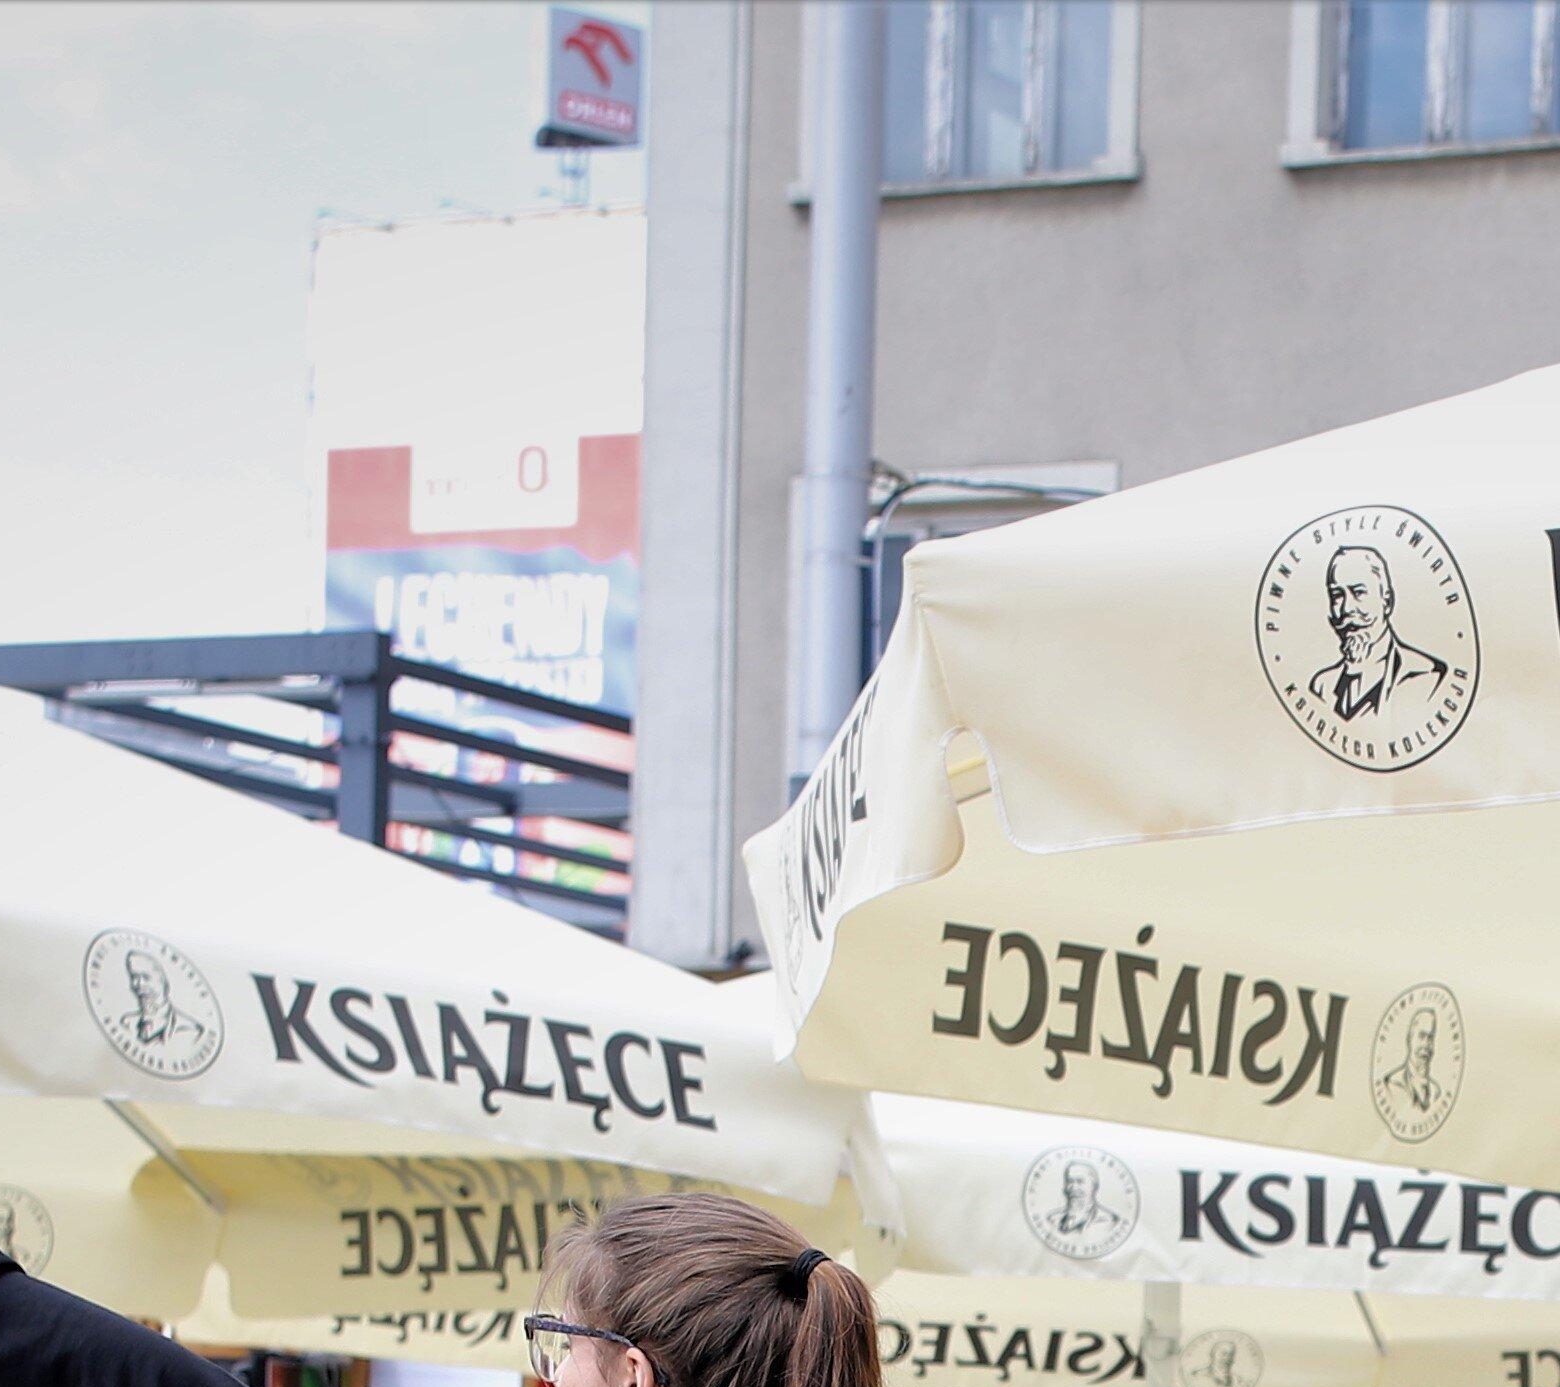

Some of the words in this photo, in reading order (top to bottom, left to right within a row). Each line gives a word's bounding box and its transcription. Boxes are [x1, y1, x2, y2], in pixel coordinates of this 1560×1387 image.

[1266, 550, 1302, 632] PIWNE
[1313, 515, 1380, 544] STYLE
[251, 989, 717, 1135] KSIĄŻĘCE
